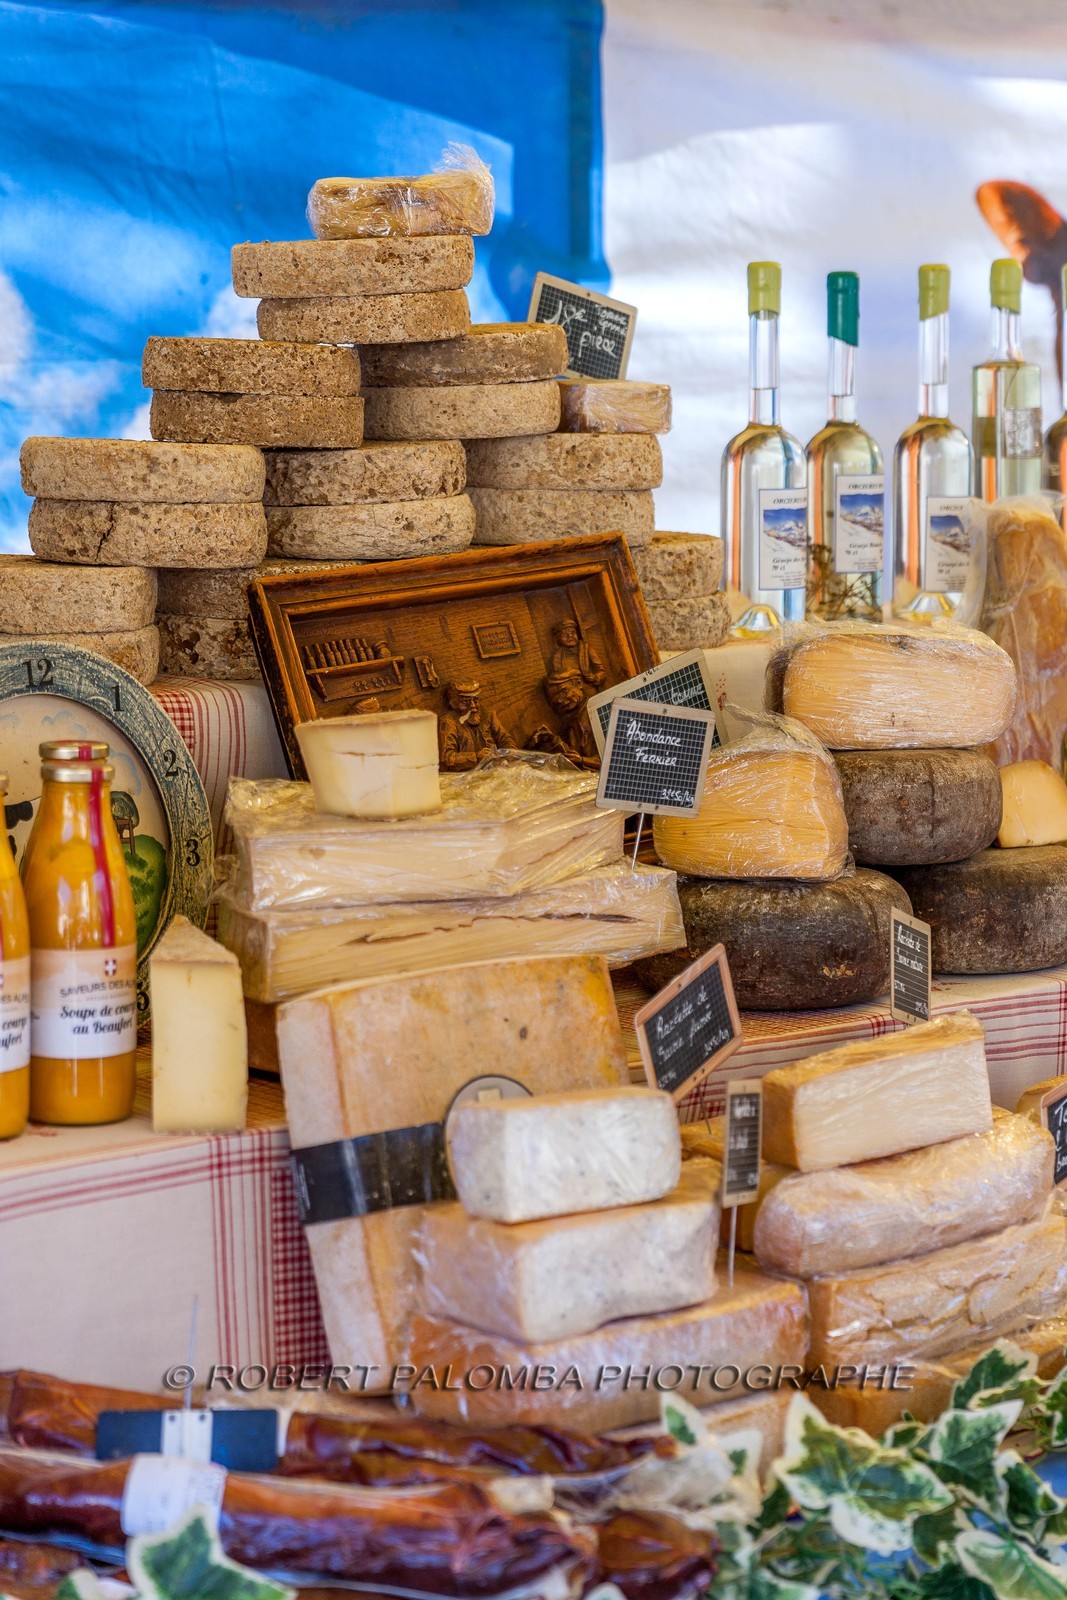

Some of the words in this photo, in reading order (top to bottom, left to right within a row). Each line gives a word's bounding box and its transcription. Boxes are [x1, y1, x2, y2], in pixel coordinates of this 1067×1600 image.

[22, 658, 54, 690] 12
[111, 685, 124, 712] 1
[626, 719, 682, 747] Abondance
[163, 749, 179, 778] 2
[186, 838, 200, 867] 3
[60, 982, 107, 998] SAVEURS
[60, 1005, 97, 1021] Soupe
[100, 1004, 112, 1017] de
[72, 1024, 89, 1035] au
[93, 1018, 133, 1034] Beaufort
